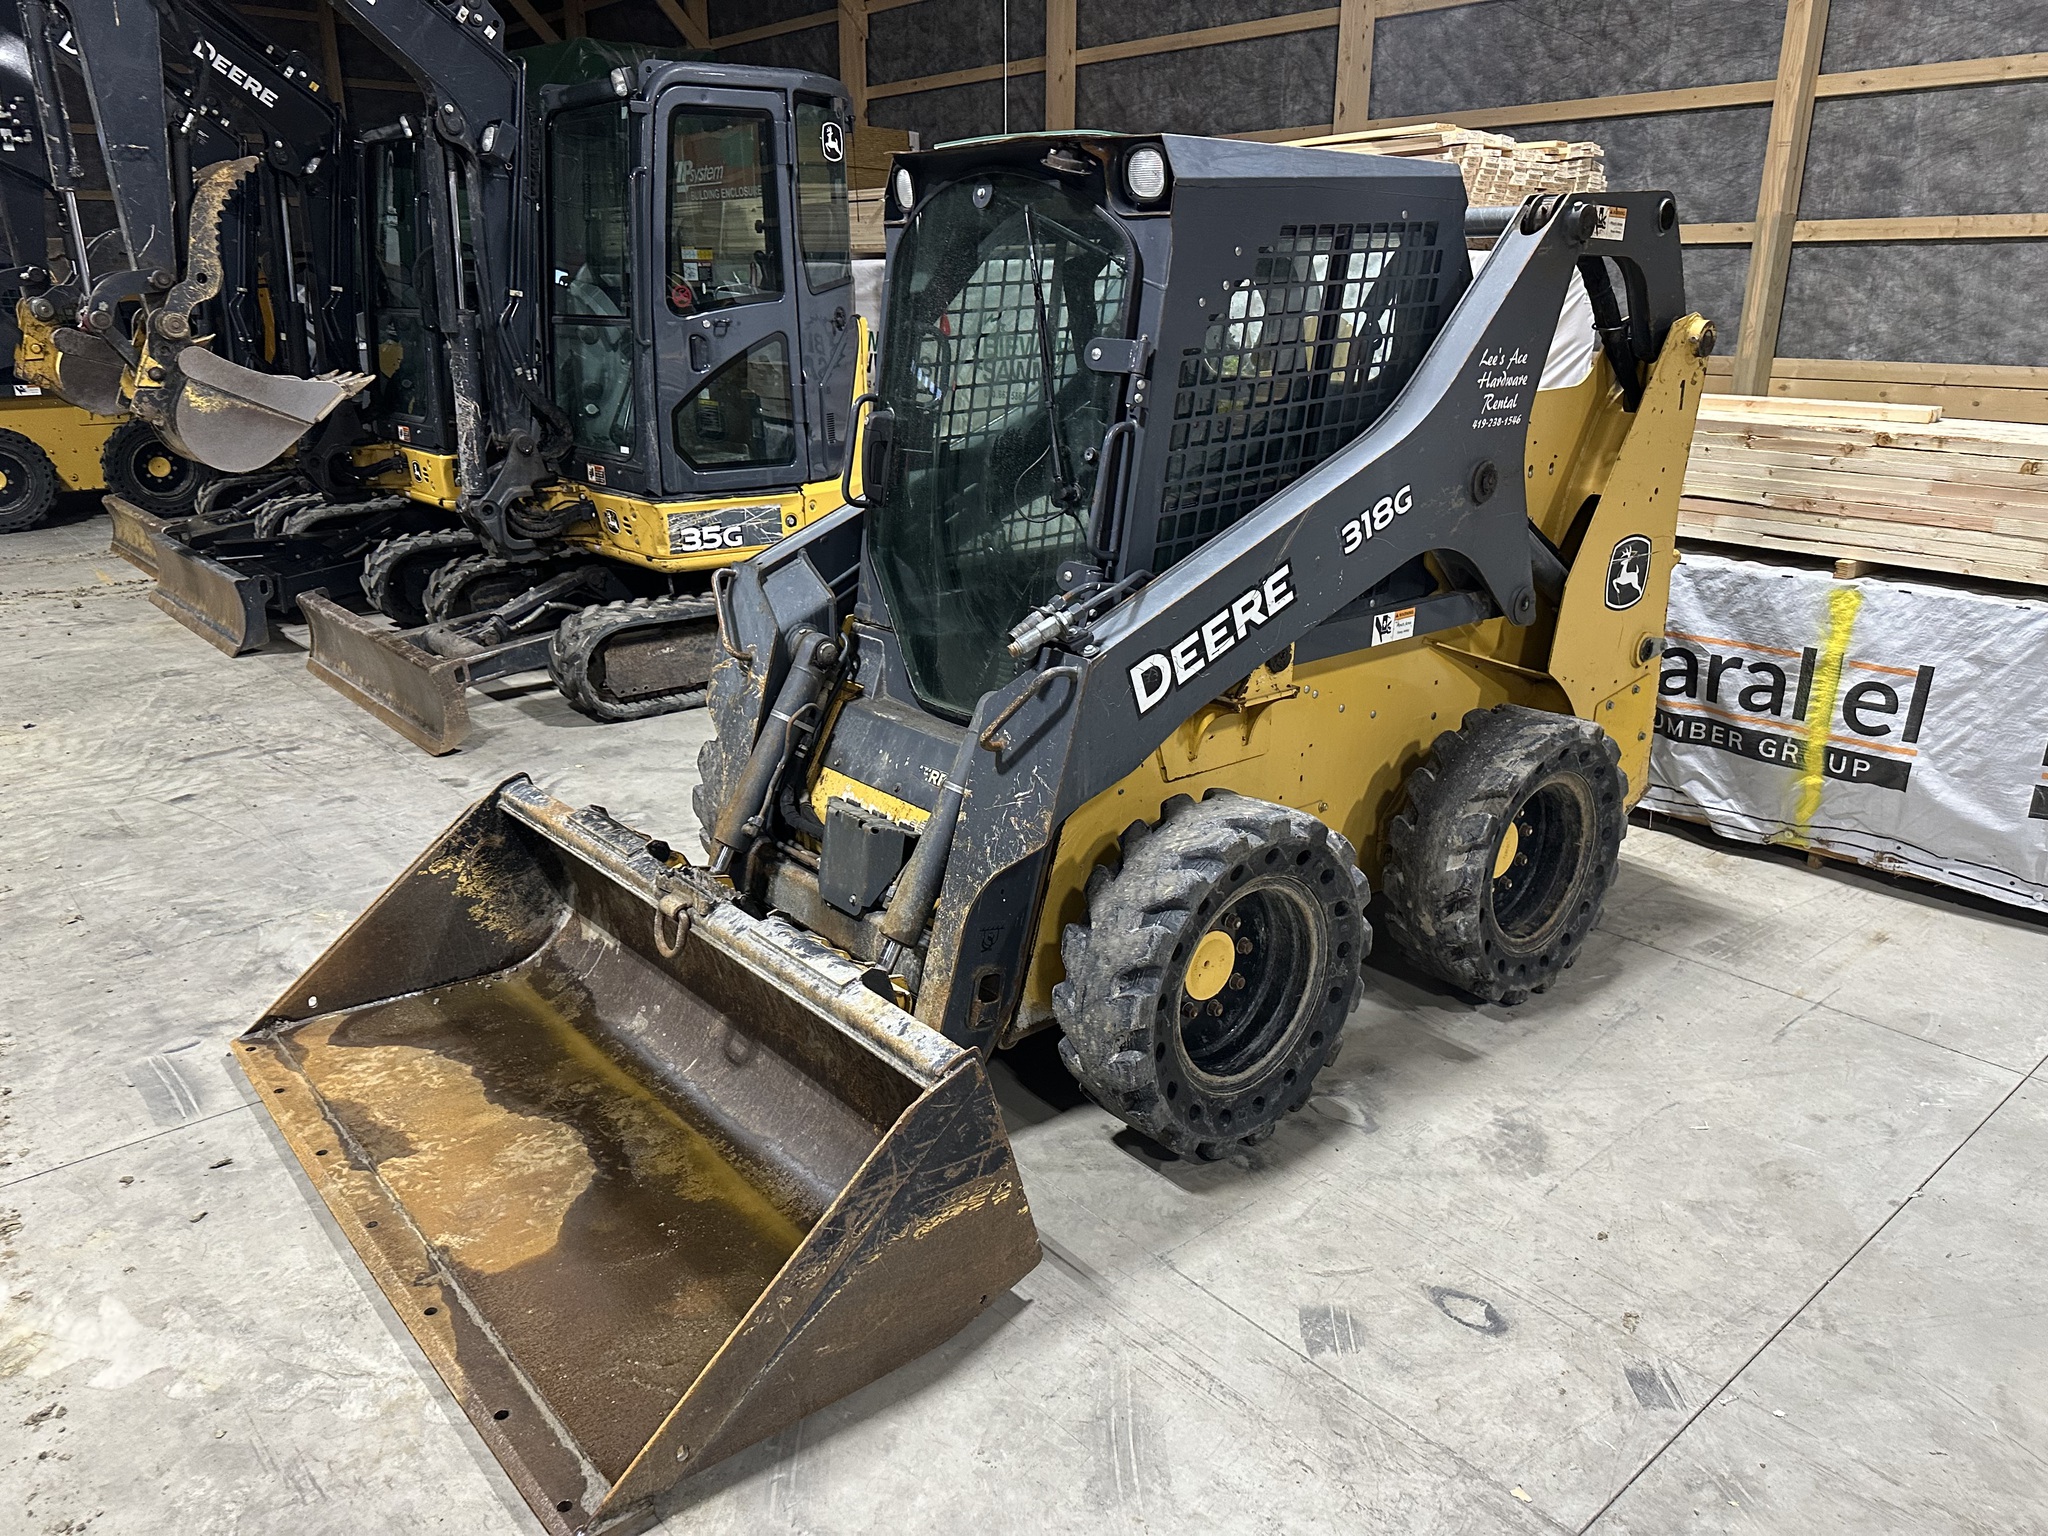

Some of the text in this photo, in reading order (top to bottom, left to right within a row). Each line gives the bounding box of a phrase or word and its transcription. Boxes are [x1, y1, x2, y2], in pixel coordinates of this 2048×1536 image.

[192, 39, 279, 108] DEERE
[690, 184, 763, 201] BUILDING ENCLOSURE
[1477, 371, 1529, 389] Hardware
[1479, 347, 1529, 370] Lee's Ace
[1481, 393, 1519, 415] Rental
[680, 526, 744, 552] 35G
[1341, 484, 1413, 554] 318G
[1129, 563, 1295, 715] DEERE
[1658, 646, 1936, 744] aralel
[1654, 713, 1871, 777] UMBER GRUP
